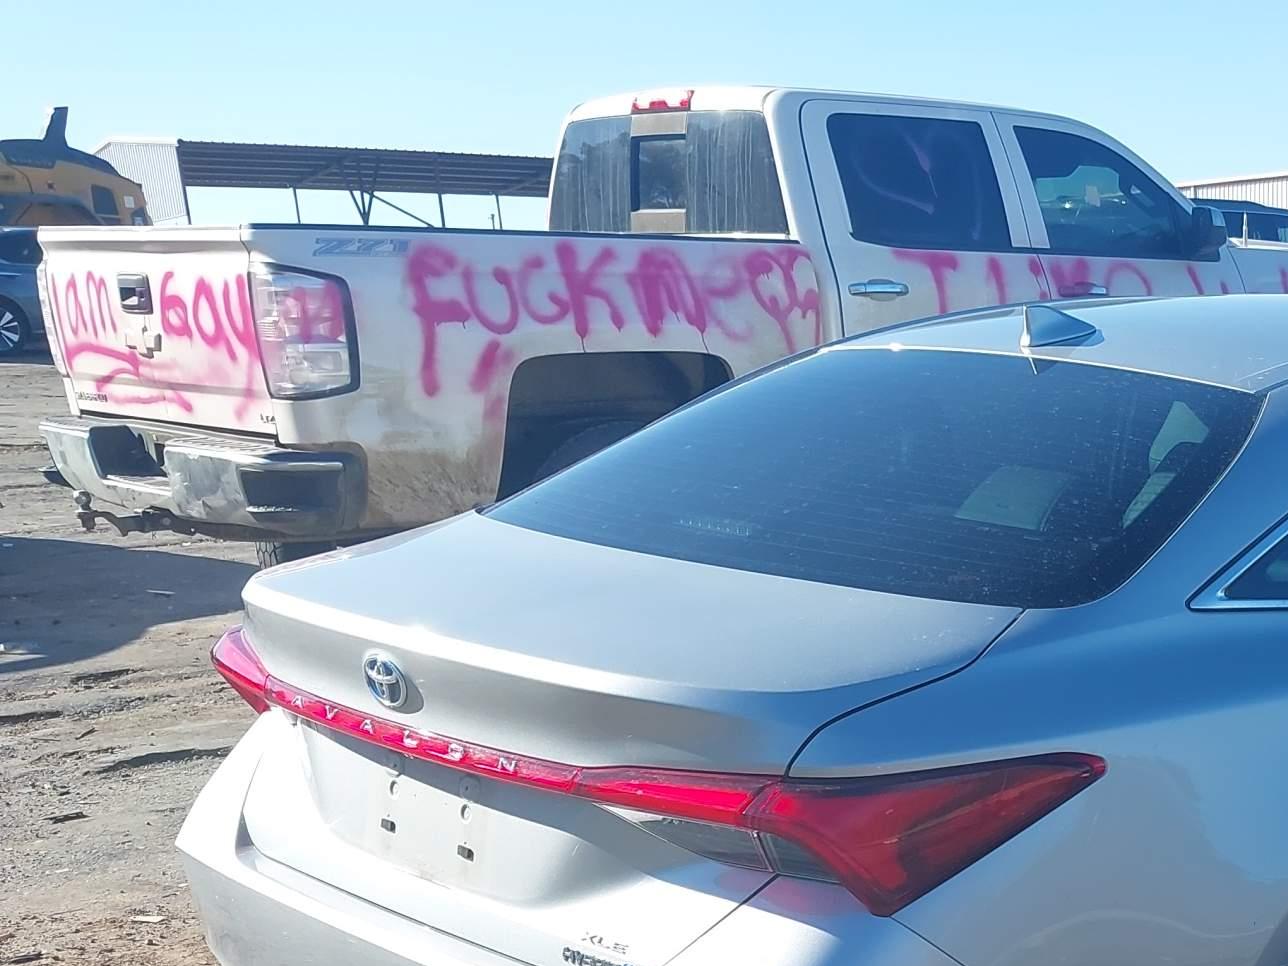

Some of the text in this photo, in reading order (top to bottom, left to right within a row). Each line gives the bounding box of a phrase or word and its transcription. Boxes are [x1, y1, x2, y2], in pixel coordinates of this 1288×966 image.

[407, 240, 625, 398] FUCK
[290, 694, 518, 775] AVALON
[580, 931, 629, 955] XLE
